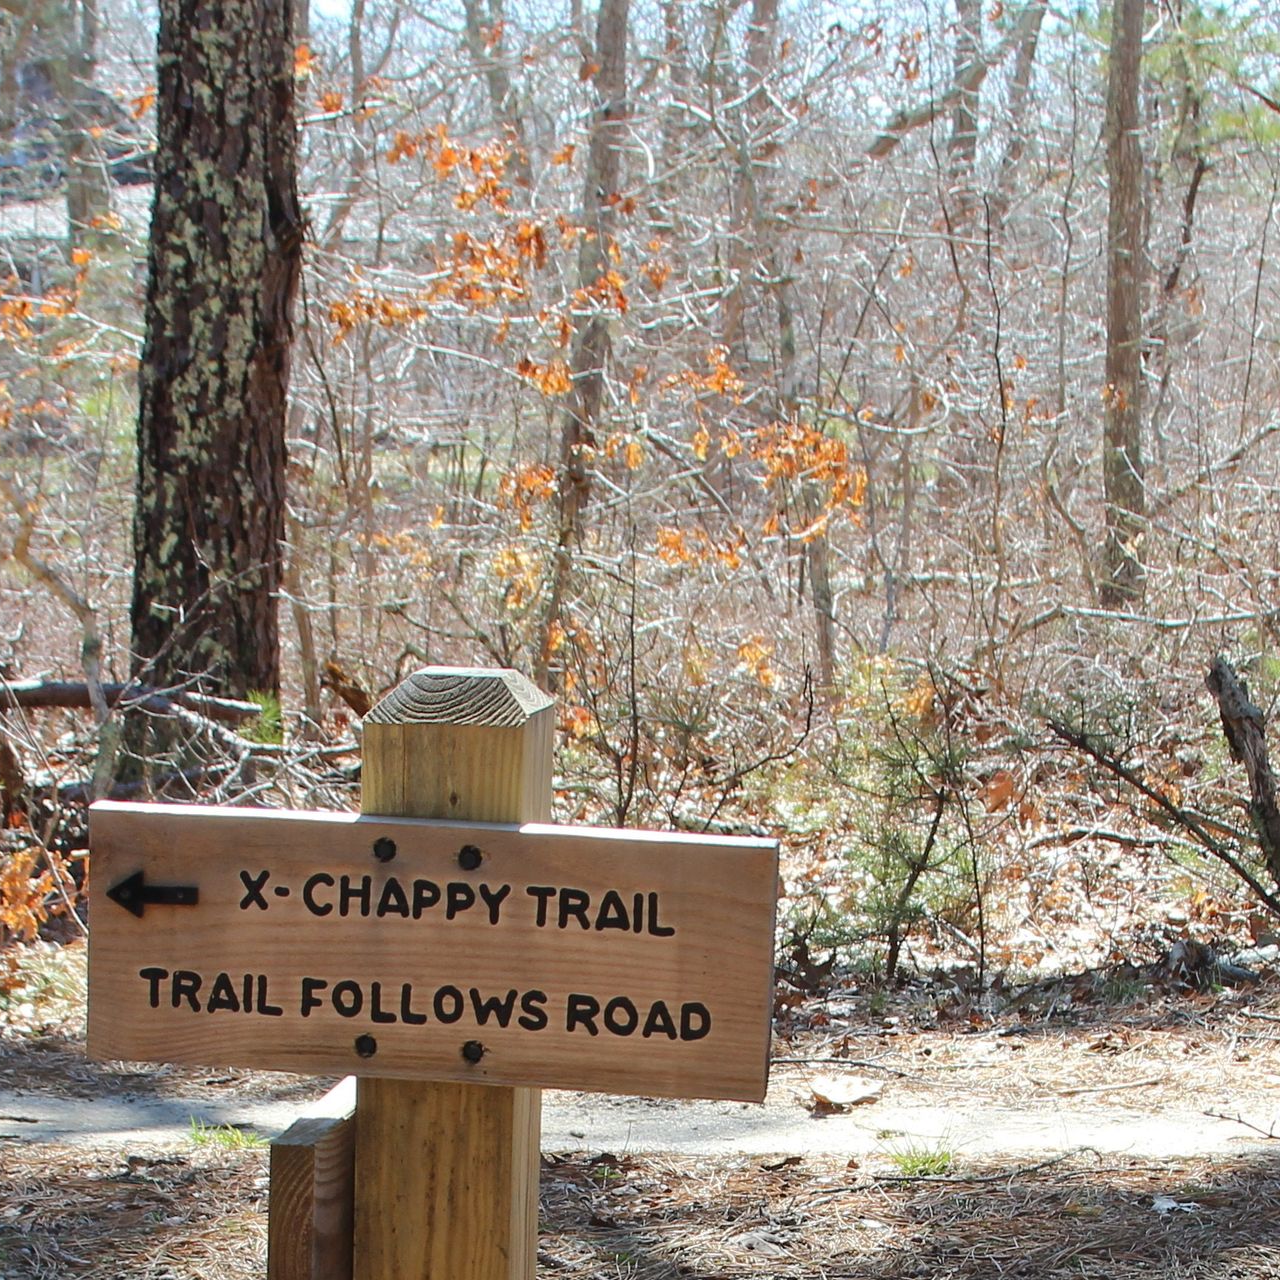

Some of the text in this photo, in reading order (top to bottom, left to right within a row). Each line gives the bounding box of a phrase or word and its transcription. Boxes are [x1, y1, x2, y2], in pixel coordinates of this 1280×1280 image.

[525, 885, 677, 938] TRAIL
[138, 966, 713, 1042] TRAIL FOLLOWS ROAD
